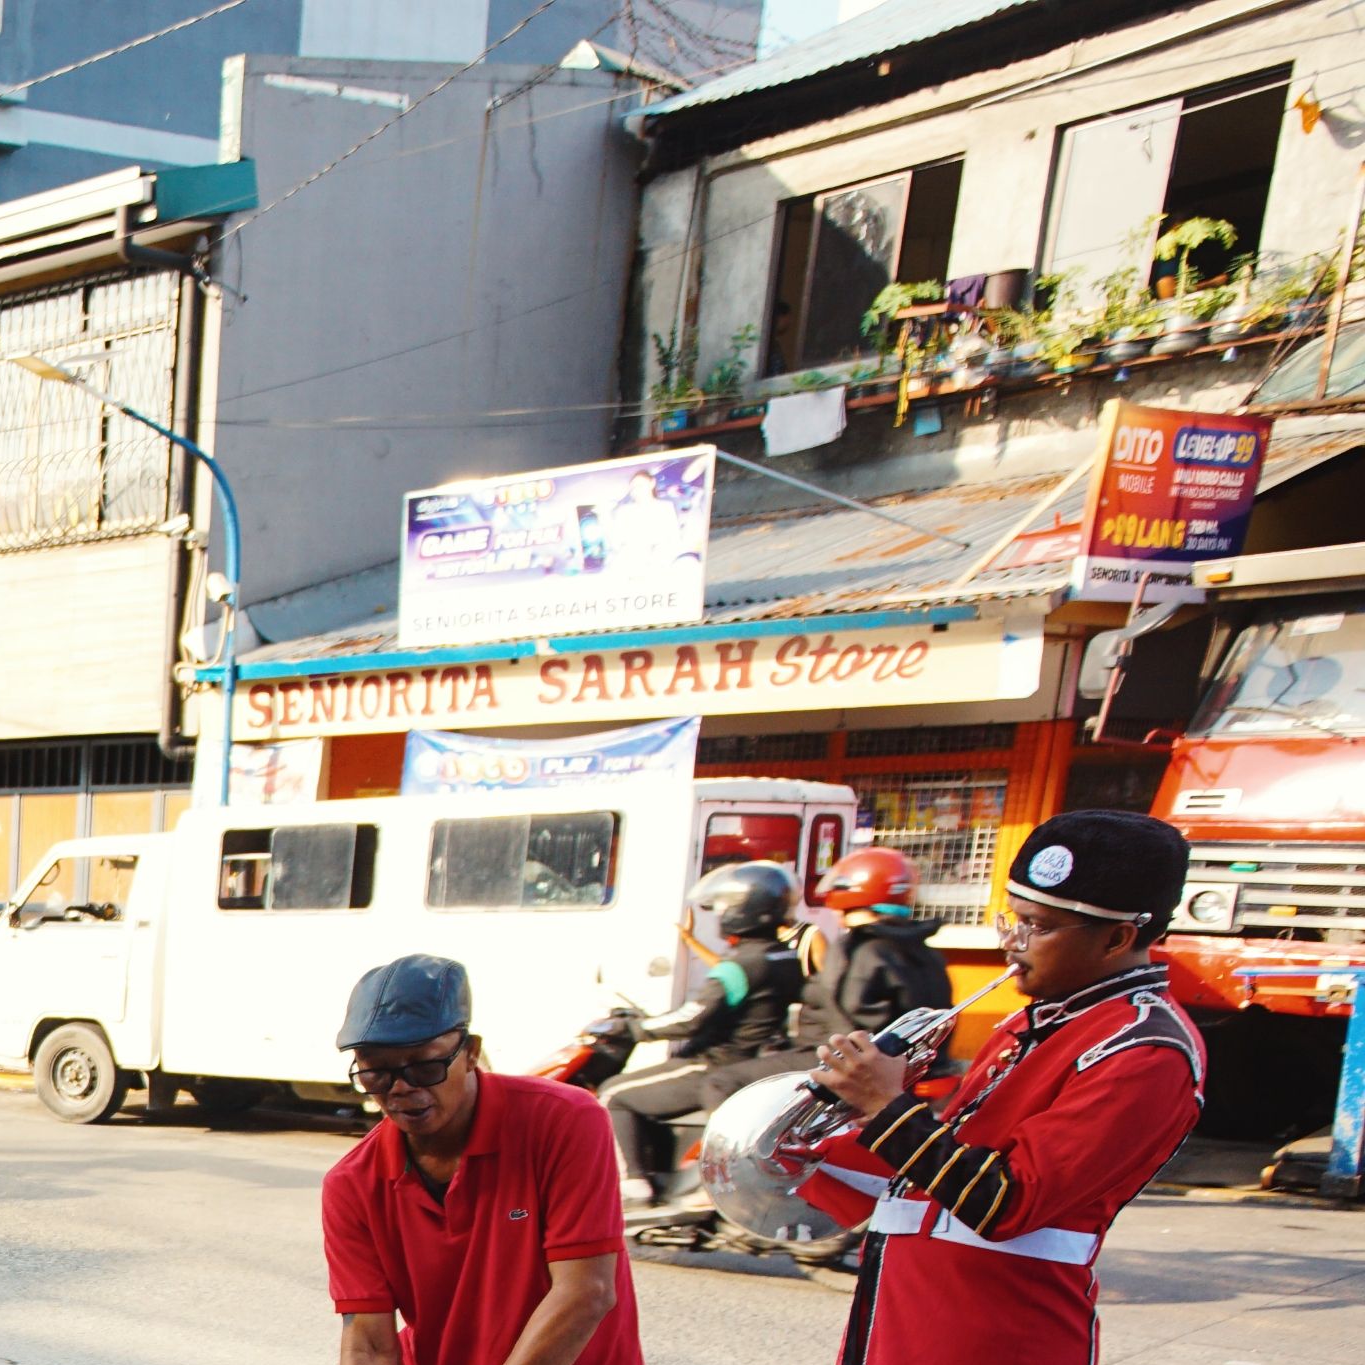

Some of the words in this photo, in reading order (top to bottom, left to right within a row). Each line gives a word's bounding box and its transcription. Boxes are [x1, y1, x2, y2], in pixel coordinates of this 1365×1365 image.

[1113, 425, 1164, 465] DITO
[1118, 473, 1156, 495] MOBILE
[1213, 488, 1243, 500] CHARGE
[1218, 471, 1246, 487] CALLS
[421, 527, 490, 558] GAME
[1135, 517, 1187, 549] LANG
[412, 609, 520, 633] SENIORITA
[526, 599, 599, 622] SARAH
[605, 591, 679, 614] STORE
[537, 639, 760, 704] SARAH
[770, 633, 932, 688] Store
